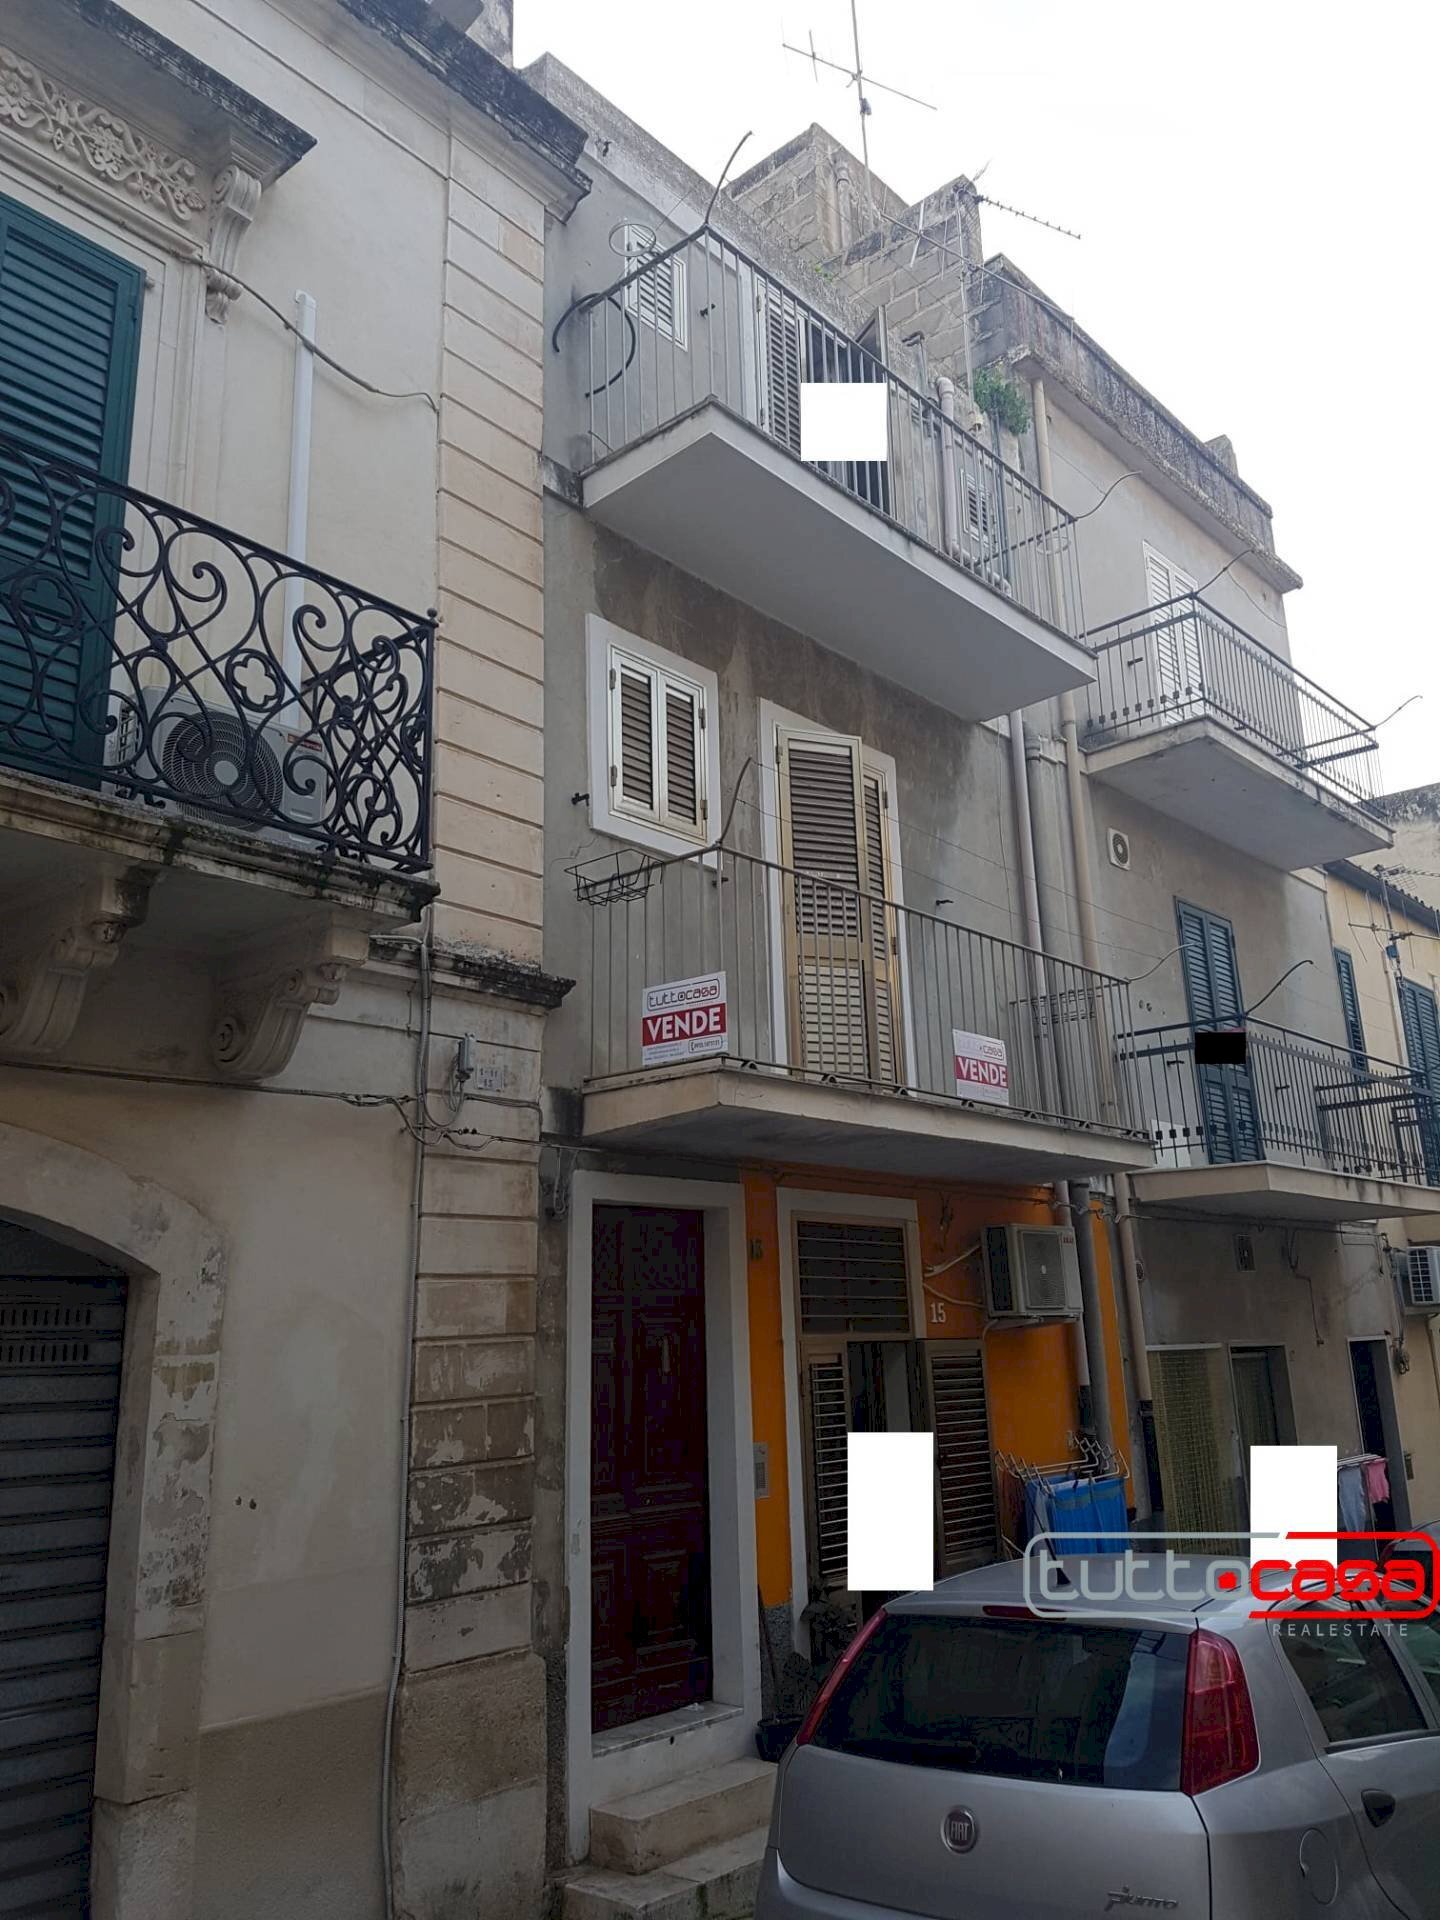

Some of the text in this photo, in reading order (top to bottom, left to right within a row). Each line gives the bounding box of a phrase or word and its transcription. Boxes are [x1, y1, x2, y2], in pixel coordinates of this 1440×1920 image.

[647, 1006, 721, 1042] VENDE
[958, 1056, 1007, 1087] VENDE
[930, 1302, 946, 1323] 15
[950, 1820, 970, 1841] FIAT
